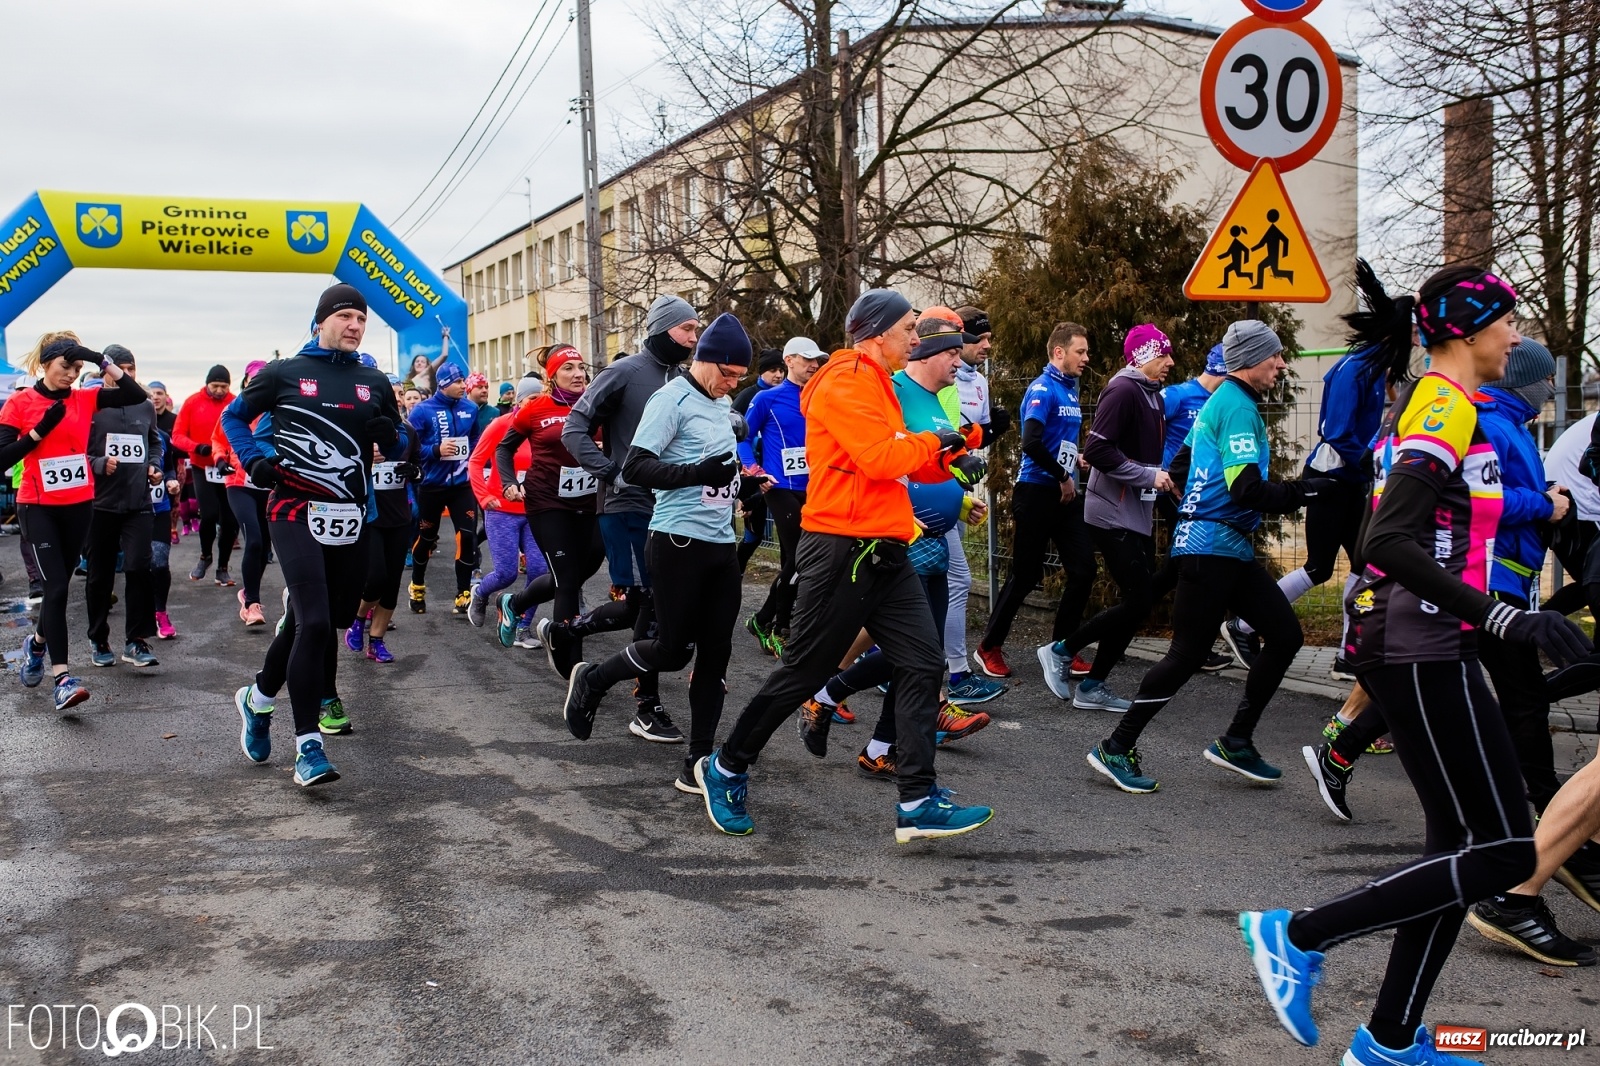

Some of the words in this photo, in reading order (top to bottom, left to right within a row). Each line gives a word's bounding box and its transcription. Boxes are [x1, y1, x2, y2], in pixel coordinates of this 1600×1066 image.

[1224, 53, 1320, 133] 30
[163, 205, 247, 219] Gmina
[141, 220, 270, 238] Pietrowice
[158, 239, 253, 255] Wielkie
[0, 237, 57, 294] ywnych
[361, 229, 405, 273] Gmina
[403, 269, 442, 306] ludzi
[348, 247, 425, 319] aktywnych
[108, 444, 143, 457] 389
[454, 445, 468, 456] 98
[1060, 451, 1076, 467] 37
[785, 457, 807, 470] 25
[45, 465, 86, 485] 394
[207, 471, 223, 479] 15
[372, 472, 404, 484] 135
[561, 476, 596, 491] 412
[1175, 467, 1209, 548] RABÓRZ
[311, 517, 359, 537] 352
[1434, 506, 1454, 568] TEAM.CZ
